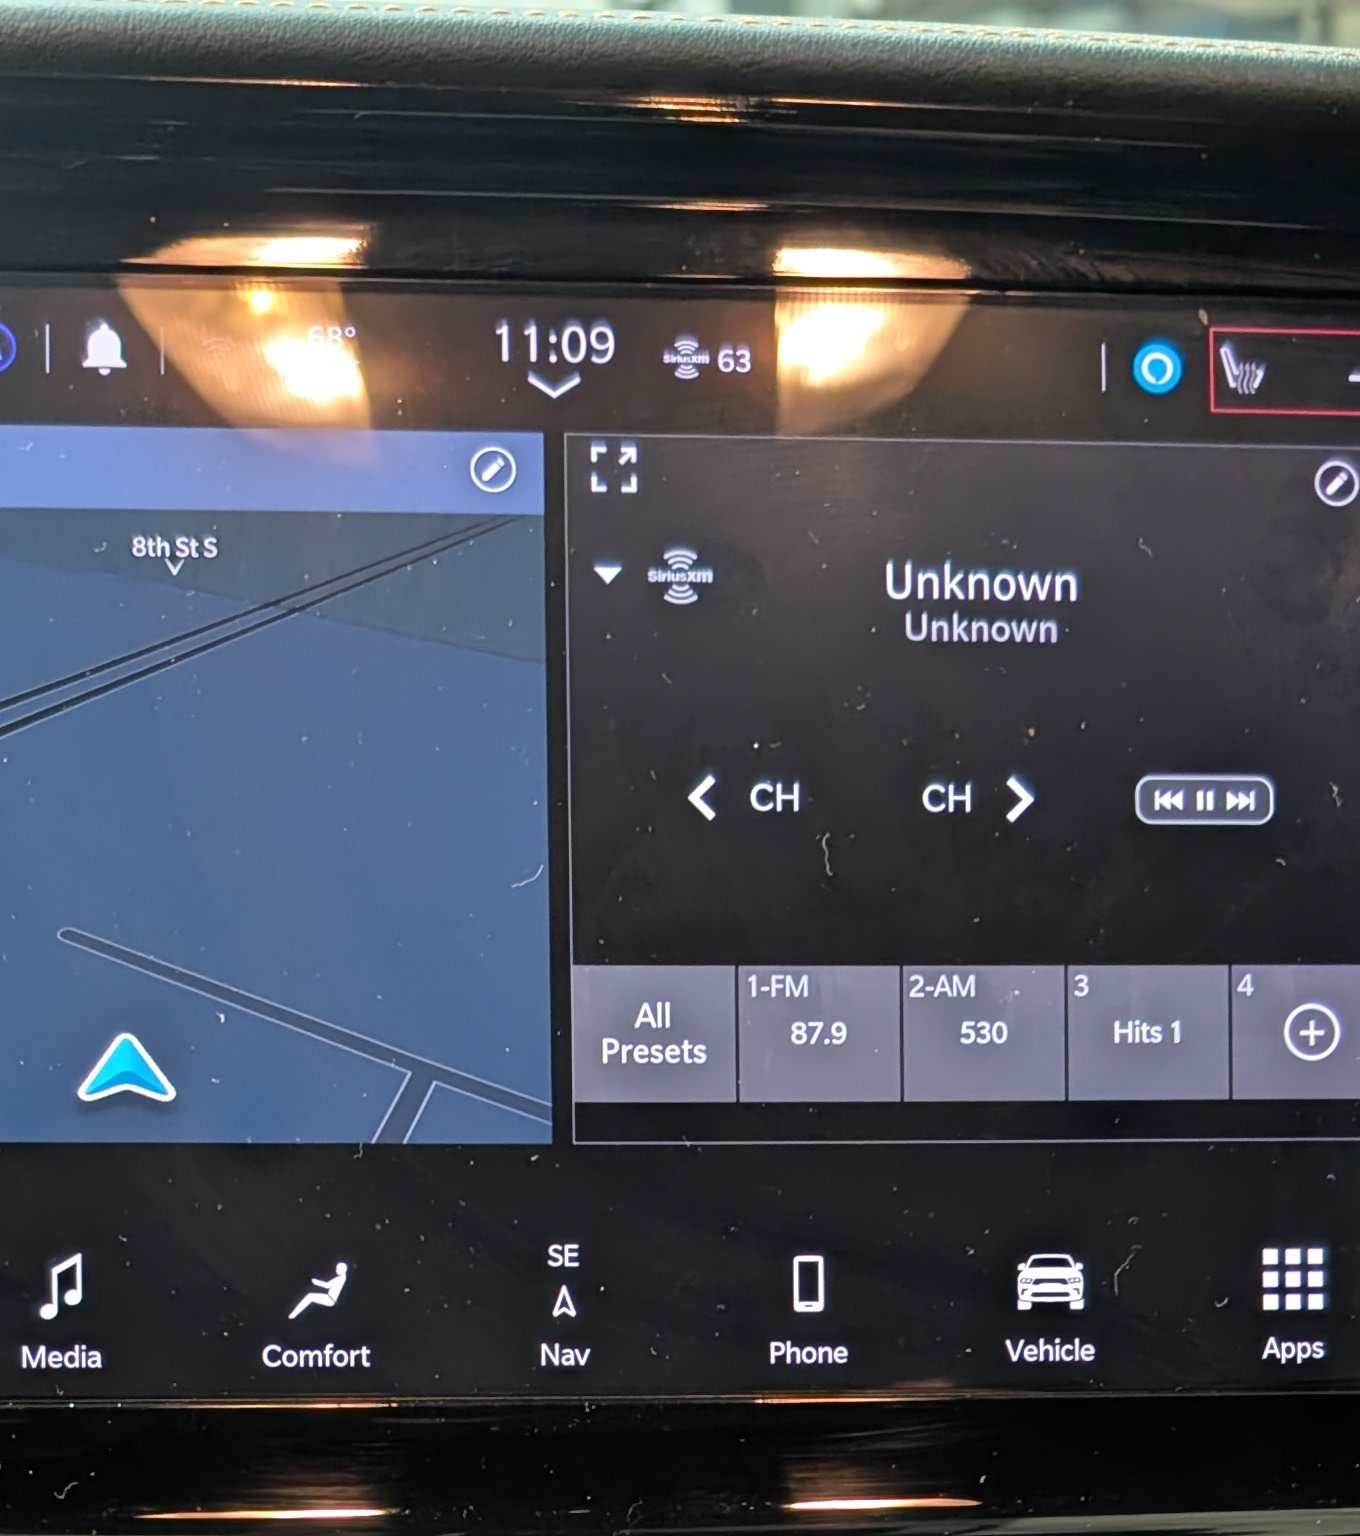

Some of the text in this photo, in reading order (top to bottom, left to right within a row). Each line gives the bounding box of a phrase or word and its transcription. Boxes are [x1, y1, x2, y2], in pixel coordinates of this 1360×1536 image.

[495, 321, 615, 365] 11:09
[717, 349, 752, 373] 63
[131, 536, 218, 559] 8th St S
[885, 561, 1078, 602] Unknown
[904, 611, 1058, 644] Unknown
[750, 782, 800, 812] CH
[922, 782, 972, 812] CH
[747, 974, 809, 998] 1-FM
[909, 974, 976, 998] 2-AM
[1073, 974, 1089, 997] 3
[1236, 974, 1254, 997] 4
[634, 1001, 671, 1029] All
[791, 1021, 848, 1045] 87.9
[960, 1020, 1009, 1045] 530
[1113, 1019, 1182, 1044] Hits 1
[602, 1037, 708, 1065] Presets
[547, 1243, 580, 1268] SE
[21, 1344, 103, 1369] Media
[262, 1343, 371, 1368] Comfort
[540, 1342, 591, 1367] Nav
[769, 1340, 849, 1365] Phone
[1005, 1337, 1096, 1362] Vehicle
[1261, 1336, 1325, 1366] Apps
